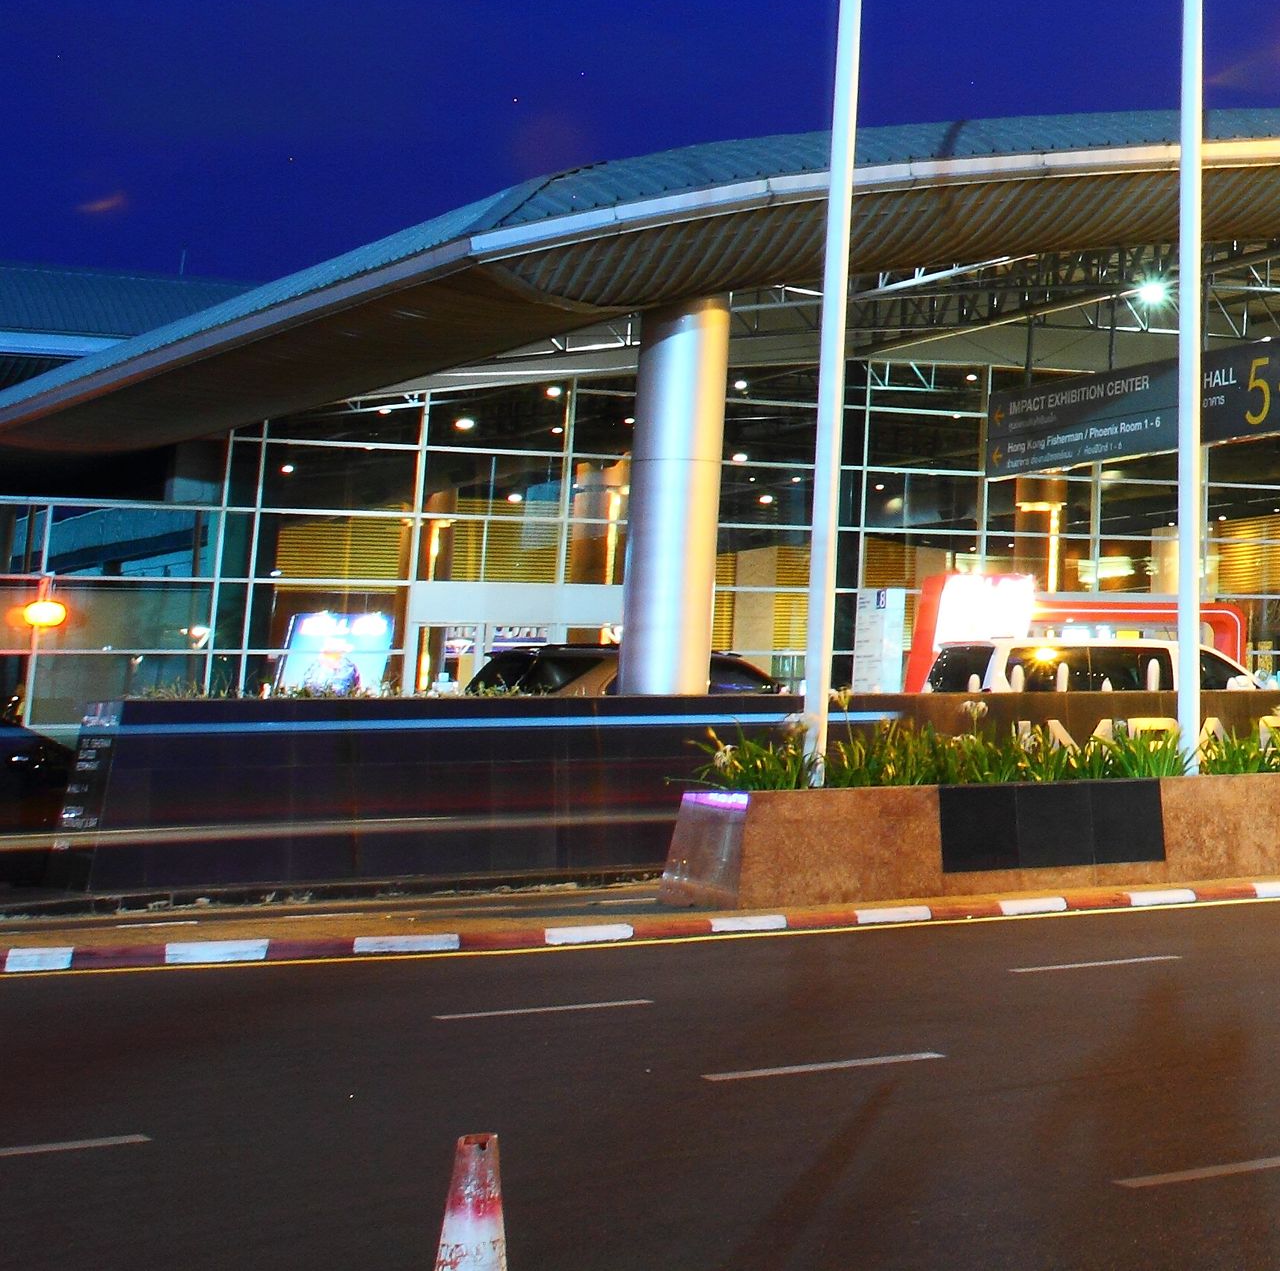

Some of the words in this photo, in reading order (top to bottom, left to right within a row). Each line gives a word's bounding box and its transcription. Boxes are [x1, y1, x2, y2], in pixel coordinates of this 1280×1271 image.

[1009, 395, 1045, 416] IMPACT
[1048, 384, 1105, 407] EXHIBITION
[1107, 375, 1150, 394] CENTER
[1204, 368, 1237, 389] HALL
[1007, 441, 1026, 454] Hong
[1027, 439, 1046, 451] Kong
[1046, 430, 1083, 446] Fisherman
[1089, 423, 1118, 439] Phoenix
[1120, 421, 1142, 433] Room
[1155, 416, 1161, 427] 6
